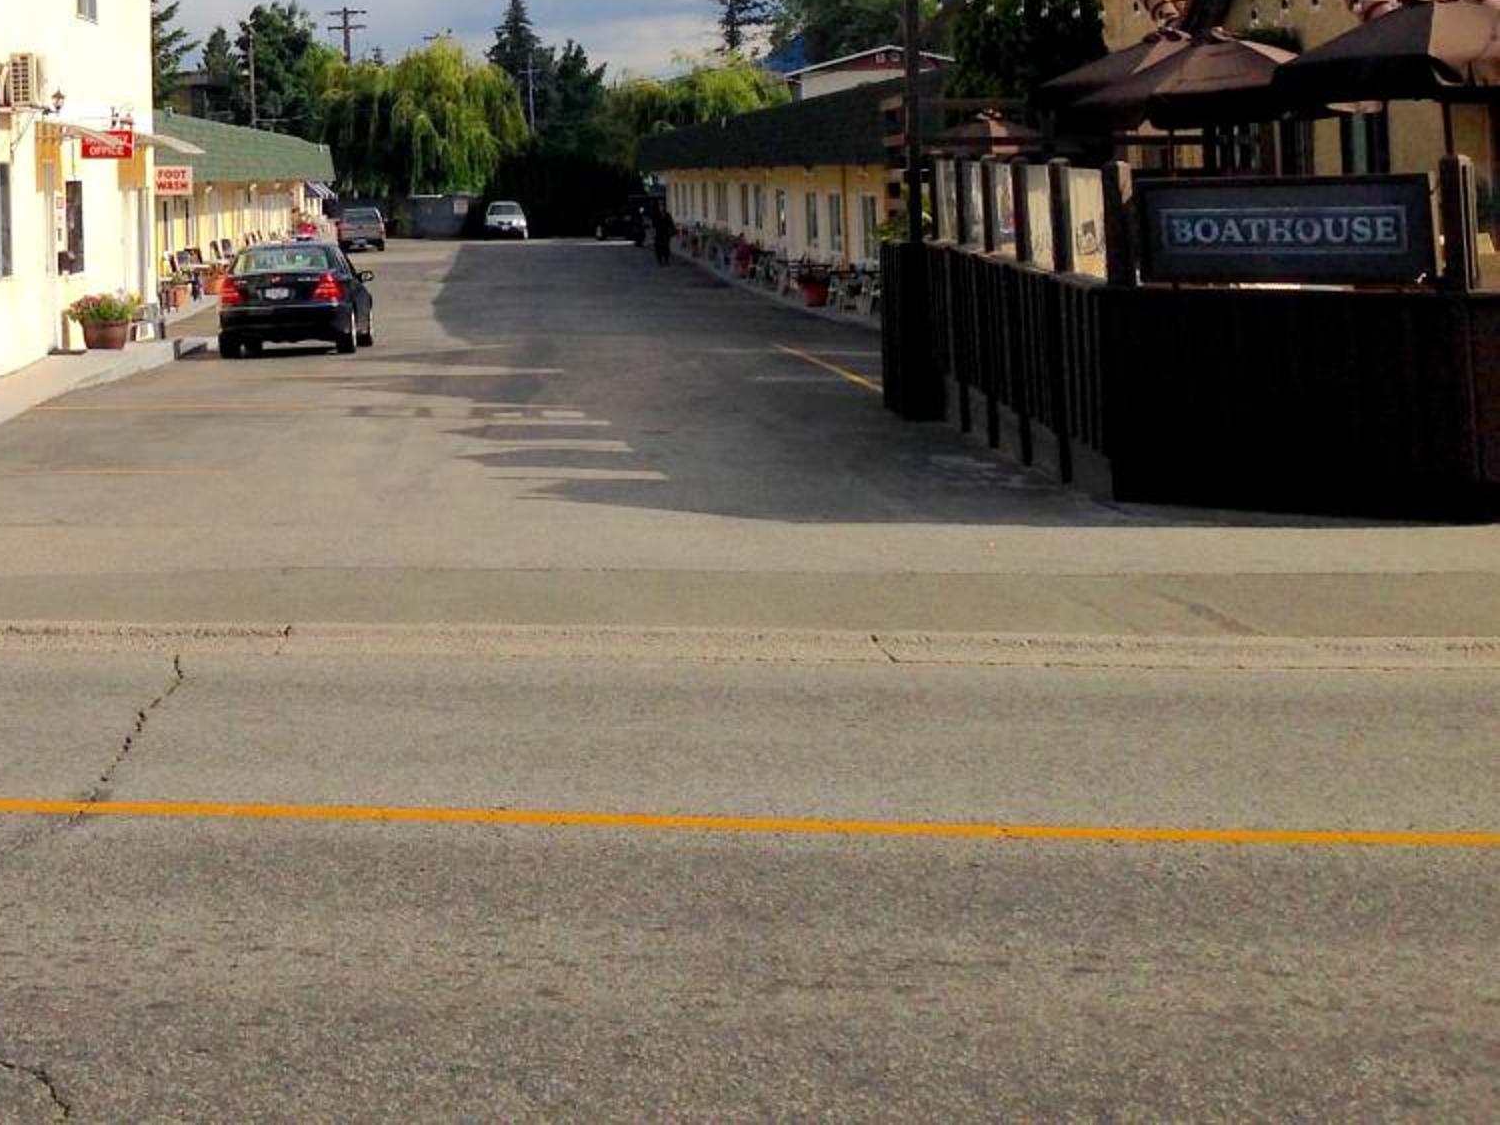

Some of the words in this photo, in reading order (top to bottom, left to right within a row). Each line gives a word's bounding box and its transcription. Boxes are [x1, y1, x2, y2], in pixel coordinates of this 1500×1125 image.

[157, 169, 187, 180] FOOT
[156, 180, 189, 191] WASH
[1172, 216, 1398, 243] BOATHOUSE
